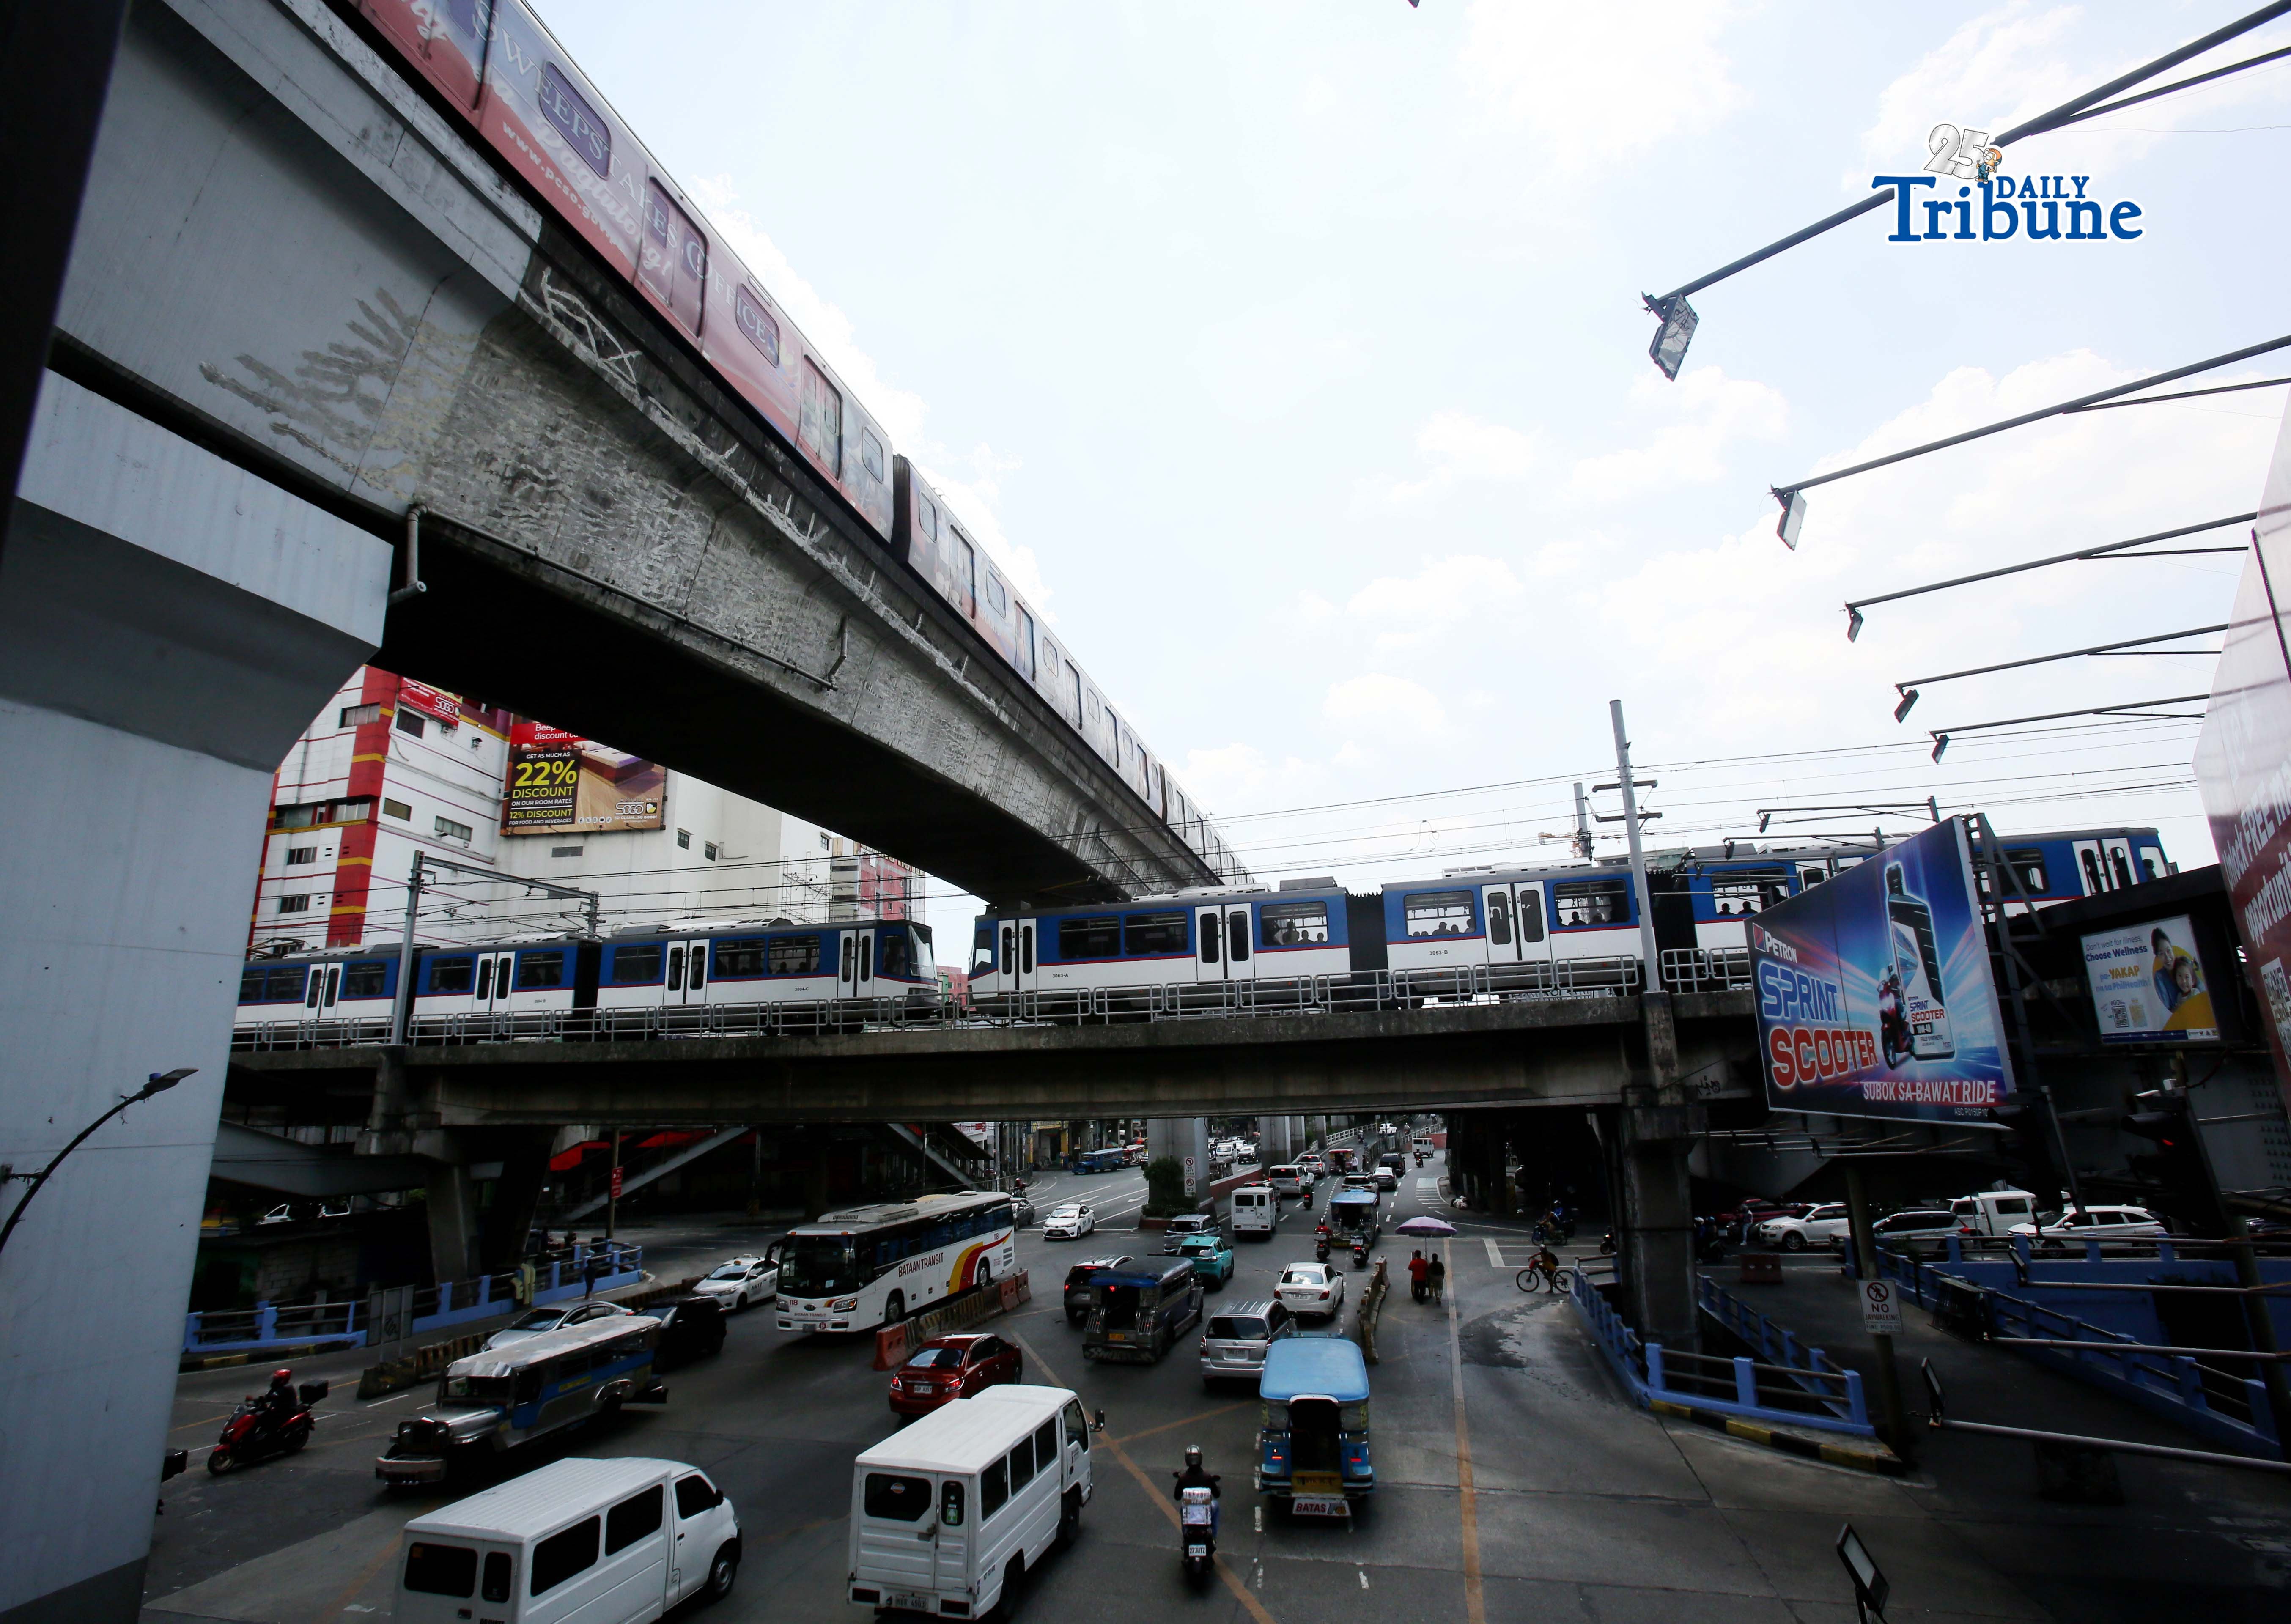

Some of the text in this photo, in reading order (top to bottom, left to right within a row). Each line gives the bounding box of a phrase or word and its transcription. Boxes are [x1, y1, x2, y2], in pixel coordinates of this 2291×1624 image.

[502, 120, 618, 249] www.pcso.gov.
[686, 240, 767, 344] OFFICE
[515, 760, 577, 787] 22%
[512, 786, 574, 799] DISCOUNT
[527, 809, 573, 818] DISCOUNT
[615, 802, 645, 815] SOGO
[2241, 777, 2276, 863] FREE
[2245, 842, 2291, 949] opportuni
[1764, 930, 1797, 963] PETRON
[2085, 945, 2148, 962] Choose Wellness
[1759, 961, 1838, 1022] SPRINT
[1910, 1000, 1929, 1012] SPRINT
[1911, 1009, 1945, 1022] SCOOTER
[1769, 1026, 1879, 1089] SCOOTER
[1863, 1081, 1896, 1100] SUBOK
[1962, 1080, 1996, 1103] RIDE
[898, 1252, 944, 1278] BATAAN TRANSIT
[1871, 1304, 1889, 1313] NO
[1296, 1503, 1327, 1512] BATAS
